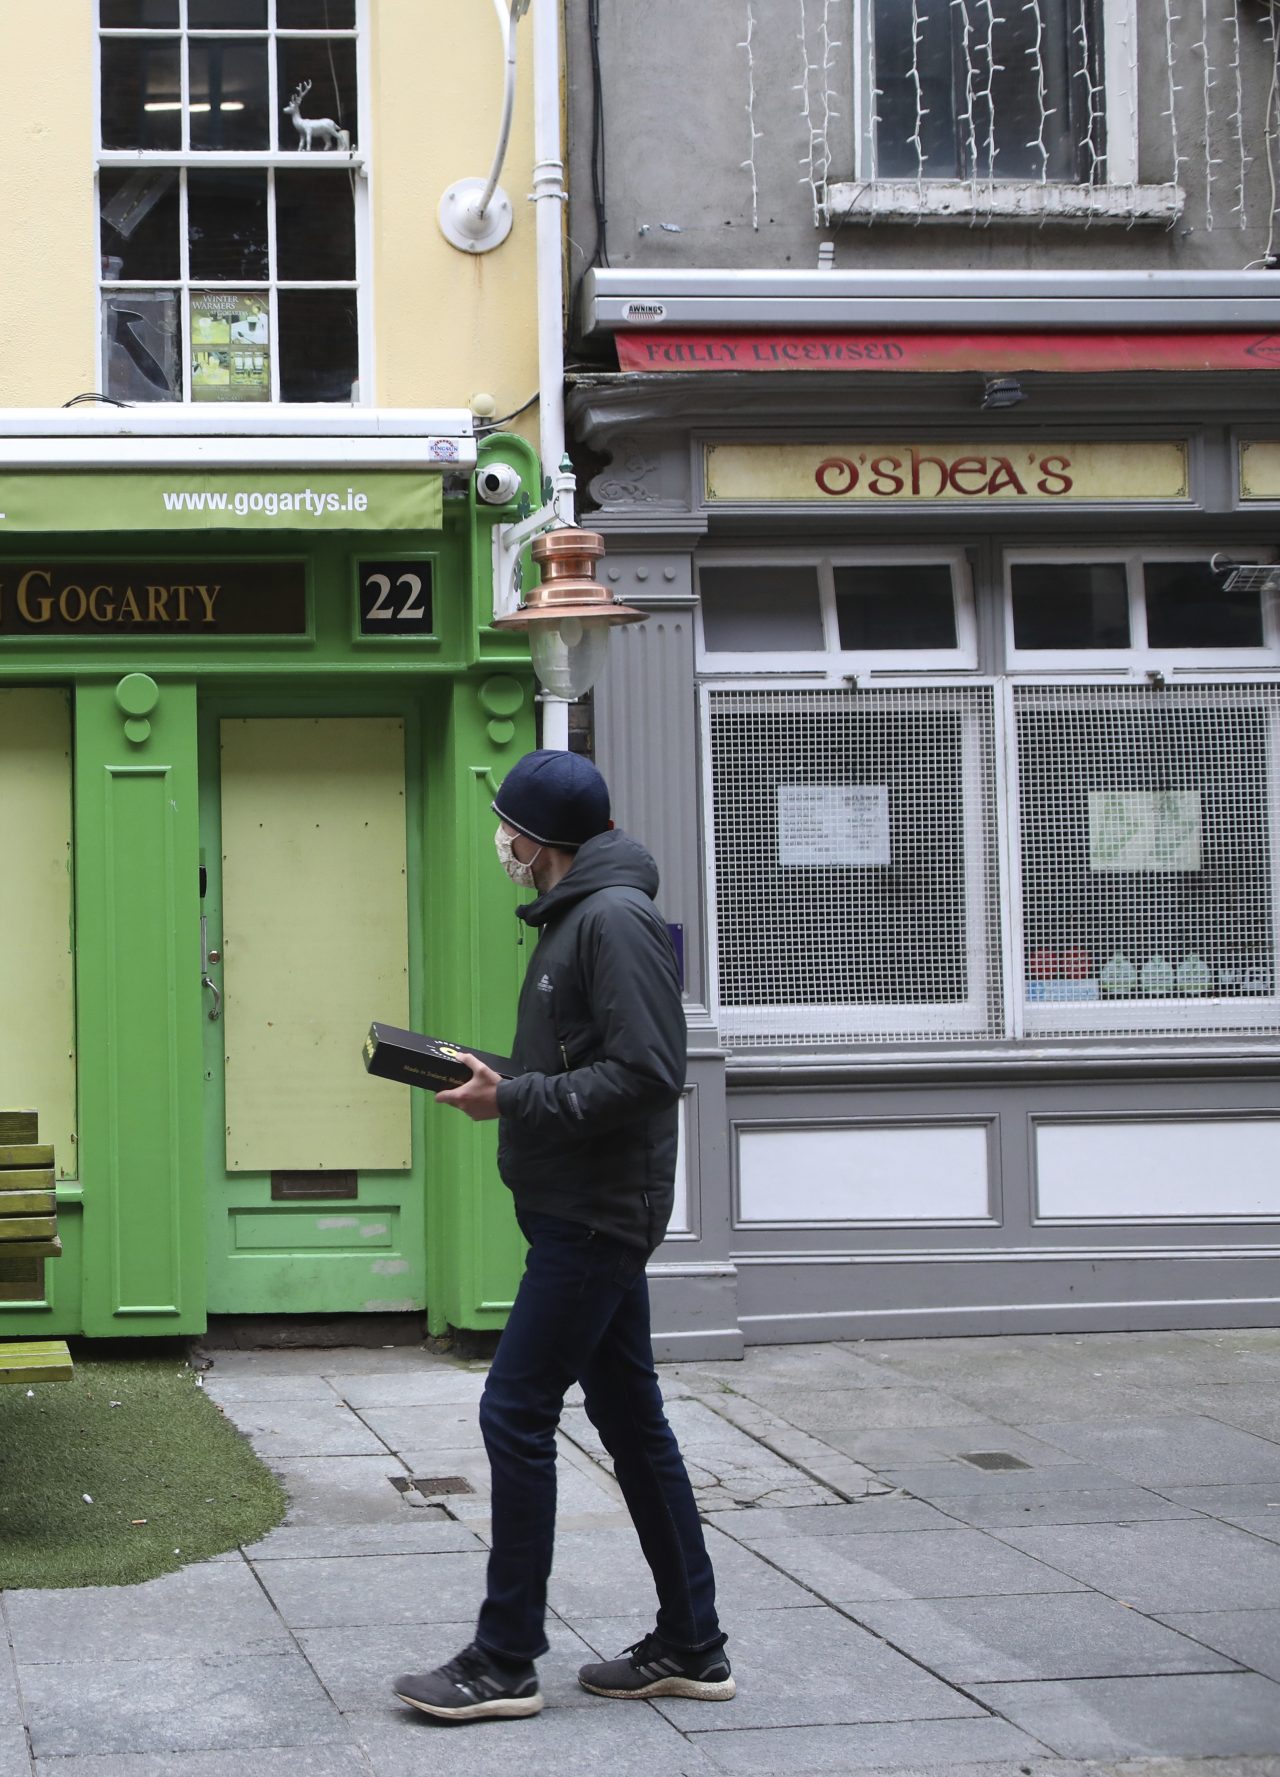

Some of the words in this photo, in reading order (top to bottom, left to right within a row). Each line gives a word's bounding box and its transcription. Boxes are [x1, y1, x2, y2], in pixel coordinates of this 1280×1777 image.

[203, 295, 239, 303] WINTER
[628, 304, 663, 315] AWNINGS
[646, 343, 740, 361] FULLY
[751, 342, 905, 361] LICENSED
[163, 488, 368, 516] www.gogartys.ie
[16, 570, 221, 624] GOGARTY
[365, 573, 425, 620] 22
